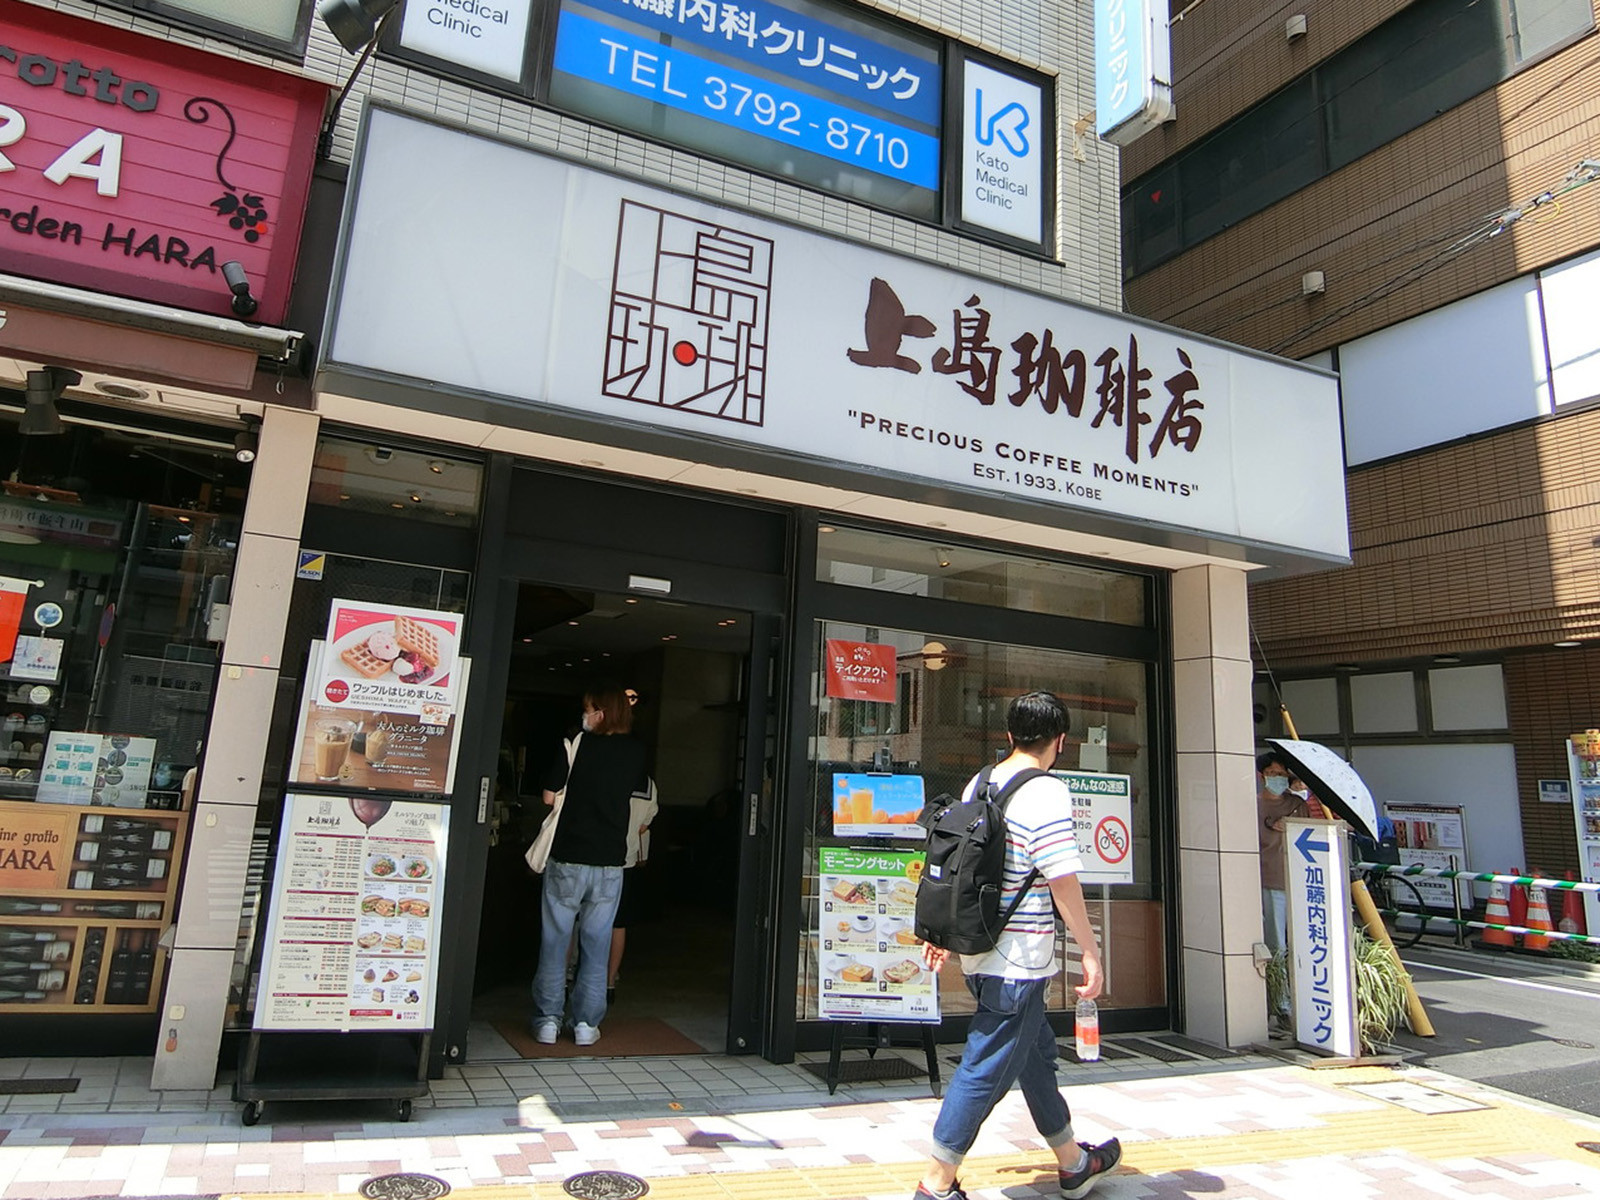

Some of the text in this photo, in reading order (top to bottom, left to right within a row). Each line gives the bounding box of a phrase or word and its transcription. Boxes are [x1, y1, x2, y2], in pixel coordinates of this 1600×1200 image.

[427, 7, 482, 38] Clinic
[436, 0, 509, 25] edical
[622, 0, 920, 100] 内科クリニック
[600, 38, 909, 169] TEL 3792-8710
[975, 150, 1009, 173] Kato
[975, 168, 1028, 197] Medical
[975, 186, 1013, 210] Clinic
[102, 222, 217, 274] HARA
[846, 276, 1204, 464] 上島珈琲店
[995, 442, 1082, 475] COFFEE
[834, 663, 888, 678] テイクアウト
[23, 830, 59, 846] grotto
[823, 856, 906, 871] モーニングセット
[1304, 865, 1333, 1044] 加藤内科クリニック
